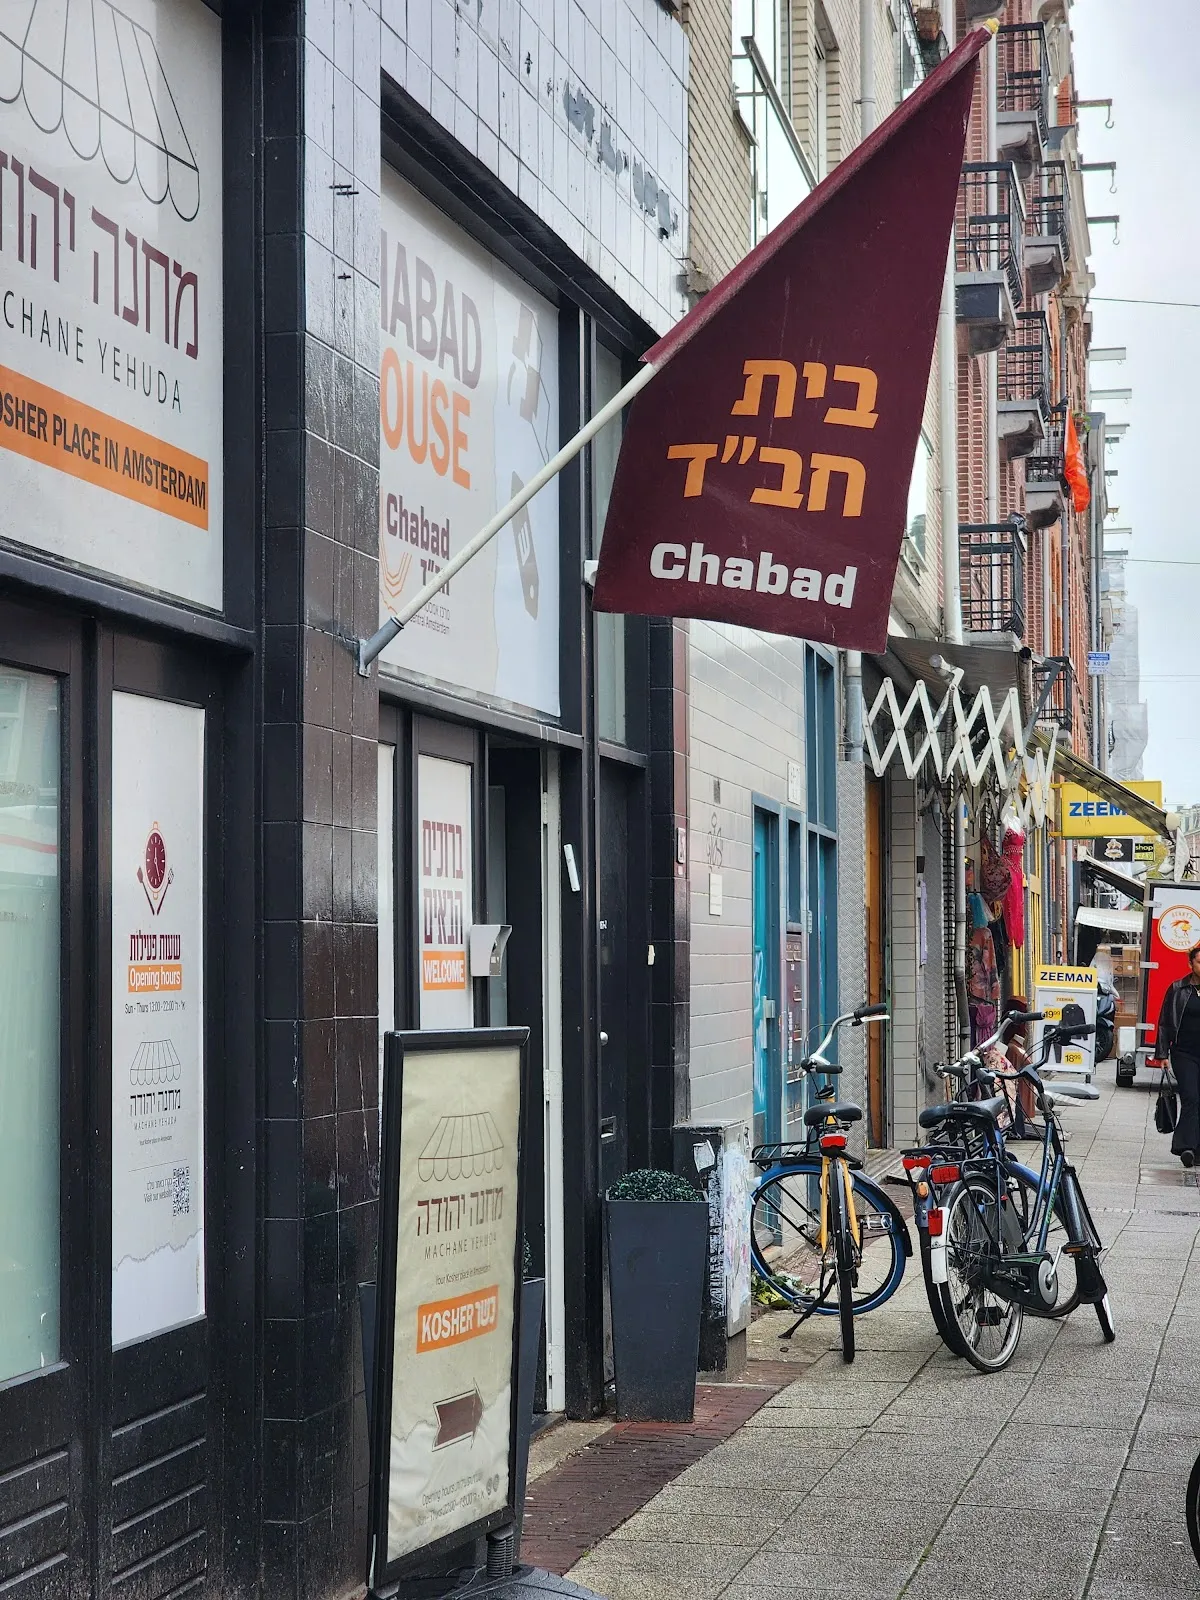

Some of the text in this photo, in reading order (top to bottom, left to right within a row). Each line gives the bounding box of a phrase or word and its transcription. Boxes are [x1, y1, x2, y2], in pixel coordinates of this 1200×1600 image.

[91, 205, 198, 360] מחנה
[98, 338, 182, 413] YEHUDA
[730, 359, 879, 429] בית
[381, 347, 471, 490] OUSE
[53, 413, 101, 465] PLACE
[104, 436, 119, 473] IN
[122, 446, 206, 510] AMSTERDAM
[386, 492, 450, 561] Chabad
[649, 542, 858, 609] Chabad
[422, 820, 464, 880] ברוכים
[1135, 844, 1154, 852] shop
[423, 888, 464, 945] הבאים
[130, 929, 181, 961] שעות פעילות
[129, 965, 181, 992] Opening hours
[424, 959, 465, 984] WELCOME
[1040, 971, 1093, 983] ZEEMAN
[124, 1003, 134, 1014] Sun
[136, 1002, 149, 1013] Thurs
[130, 1089, 181, 1117] מחנה יהודה
[417, 1187, 503, 1236] מחנה יהודה
[425, 1232, 497, 1260] MACHANE YEHUDA
[422, 1296, 497, 1344] KOSHER כשר
